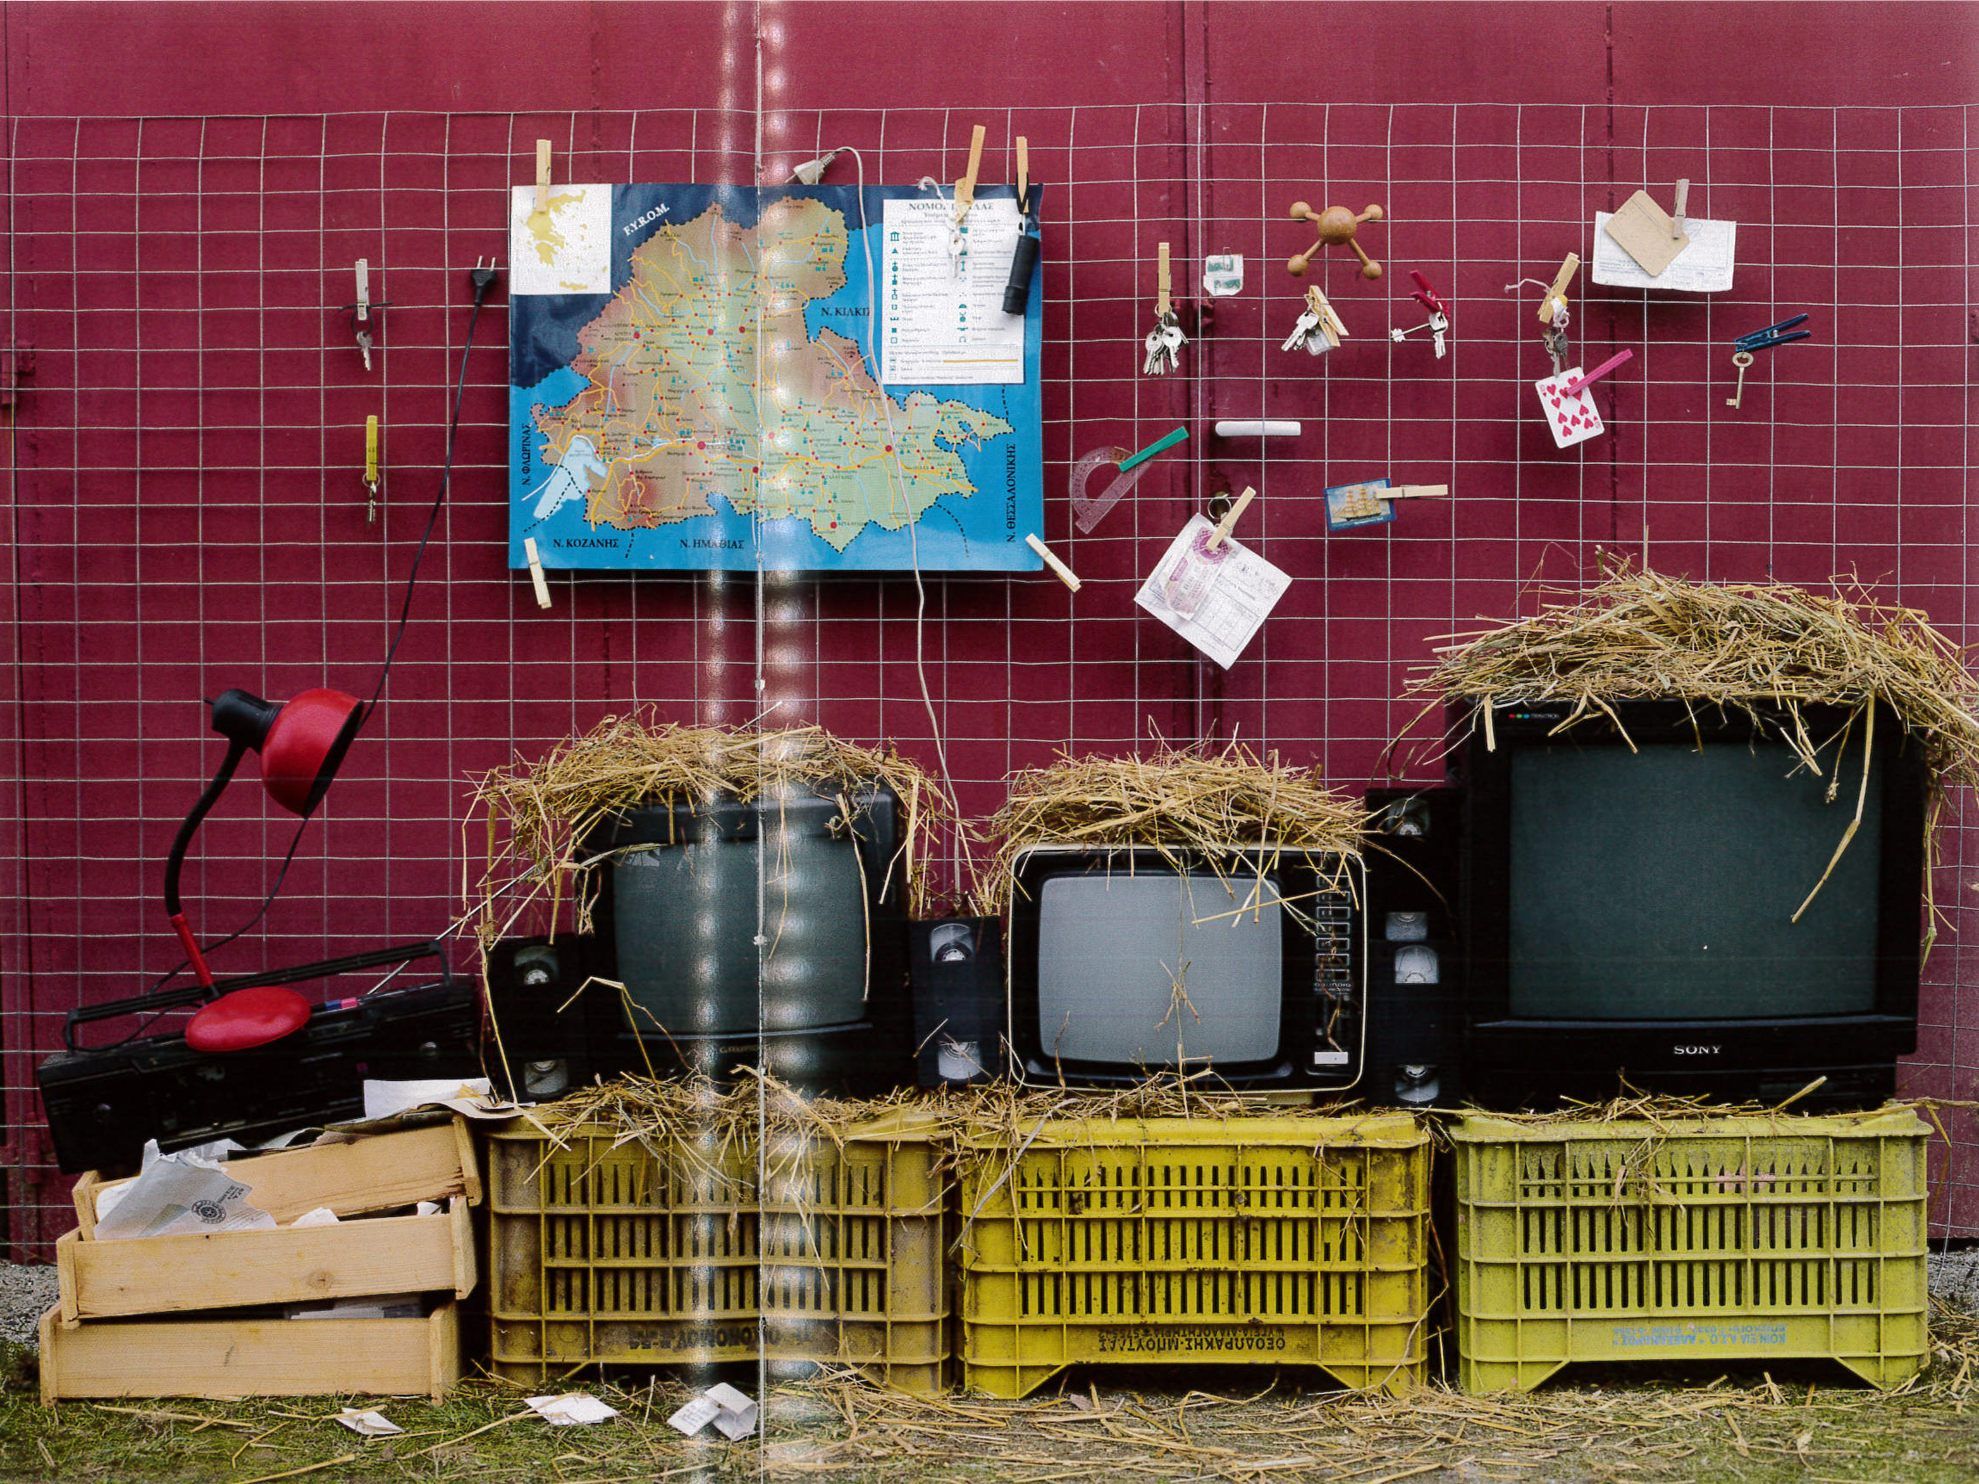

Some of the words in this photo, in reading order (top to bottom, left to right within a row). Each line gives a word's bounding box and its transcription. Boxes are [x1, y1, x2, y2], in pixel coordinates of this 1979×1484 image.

[1006, 443, 1016, 529] ΘΕΣΣΑΛΟΝΙΚΗΣ
[553, 539, 564, 548] Ν.
[566, 539, 619, 548] ΚΟΖΑΝΗΣ
[680, 540, 691, 549] Ν.
[1673, 1045, 1721, 1054] SONY
